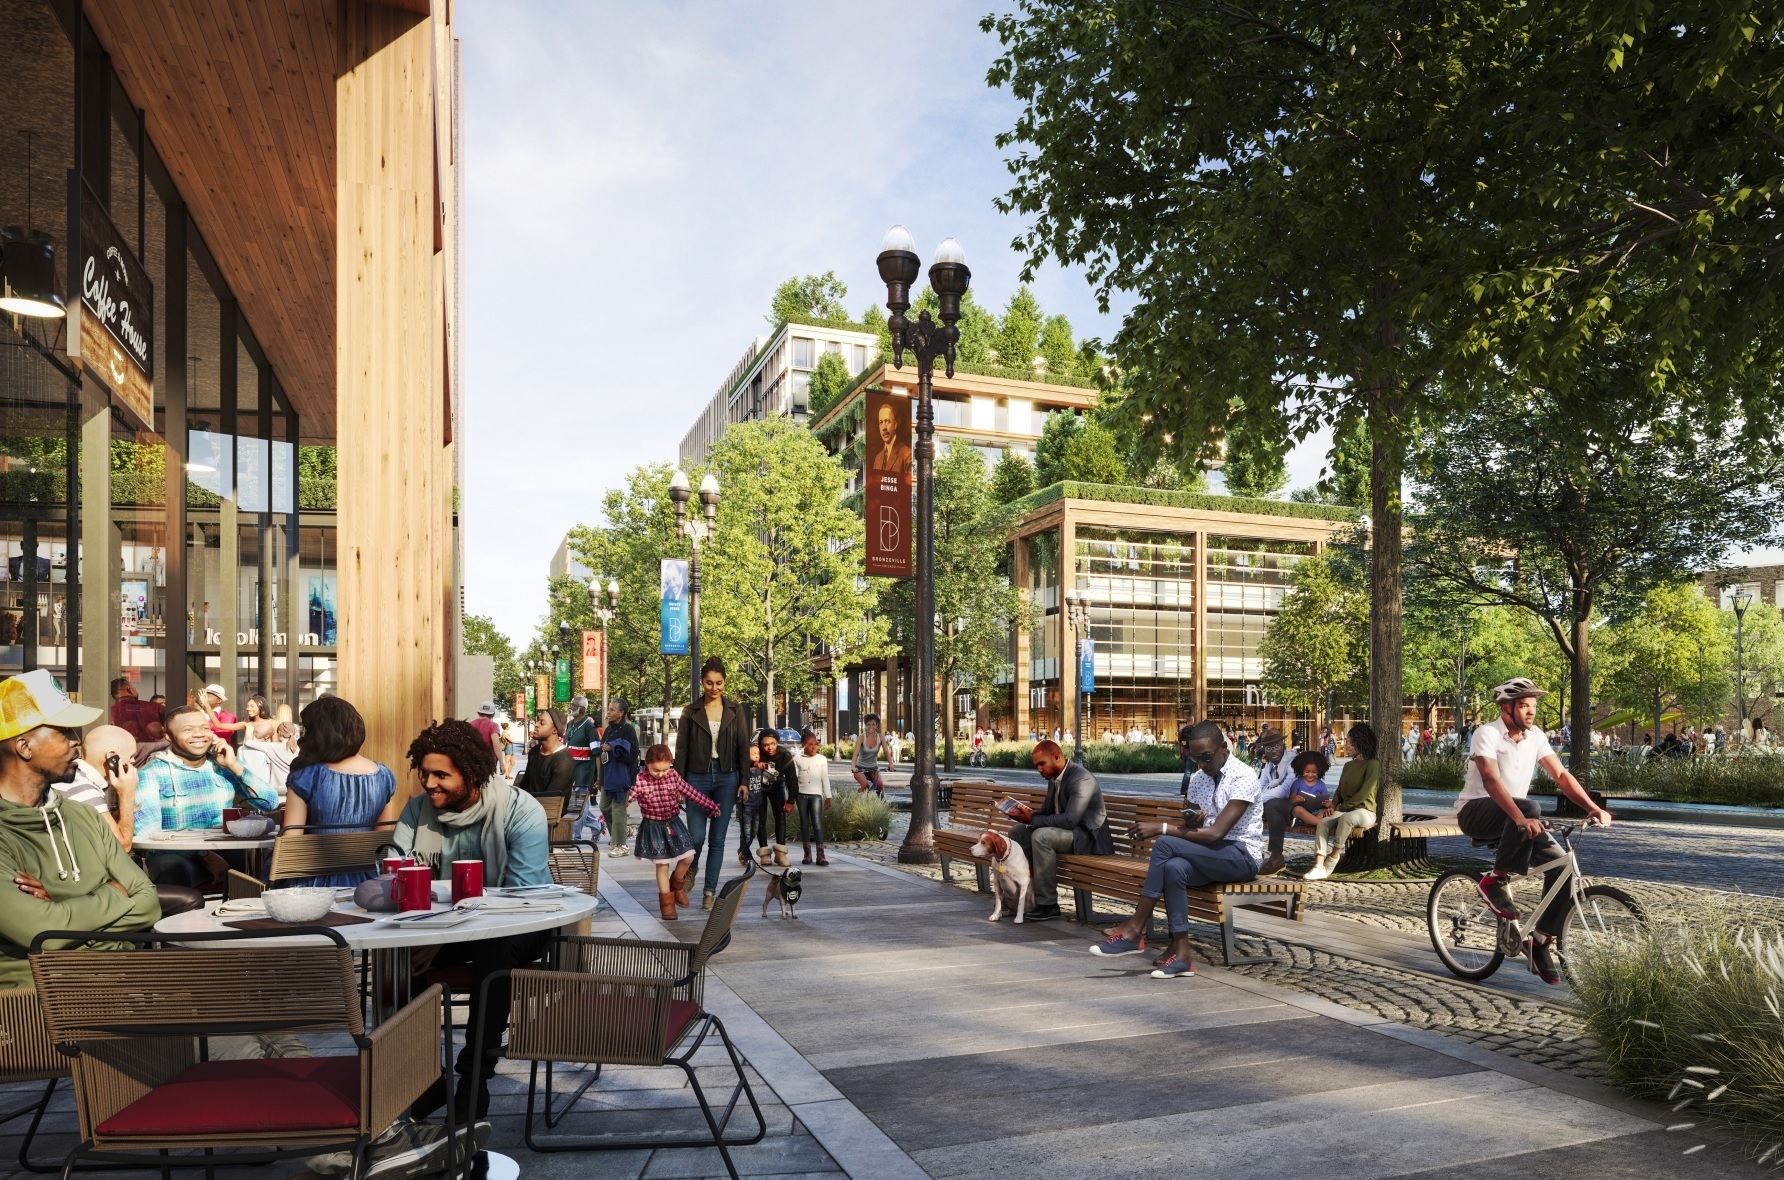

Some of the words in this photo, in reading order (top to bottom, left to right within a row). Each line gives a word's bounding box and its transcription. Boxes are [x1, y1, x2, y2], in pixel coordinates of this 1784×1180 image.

[83, 255, 117, 324] Coffee
[119, 300, 147, 361] House
[880, 476, 898, 484] JESSE
[880, 484, 898, 492] BINGA
[871, 556, 906, 564] BRONZEVILLE
